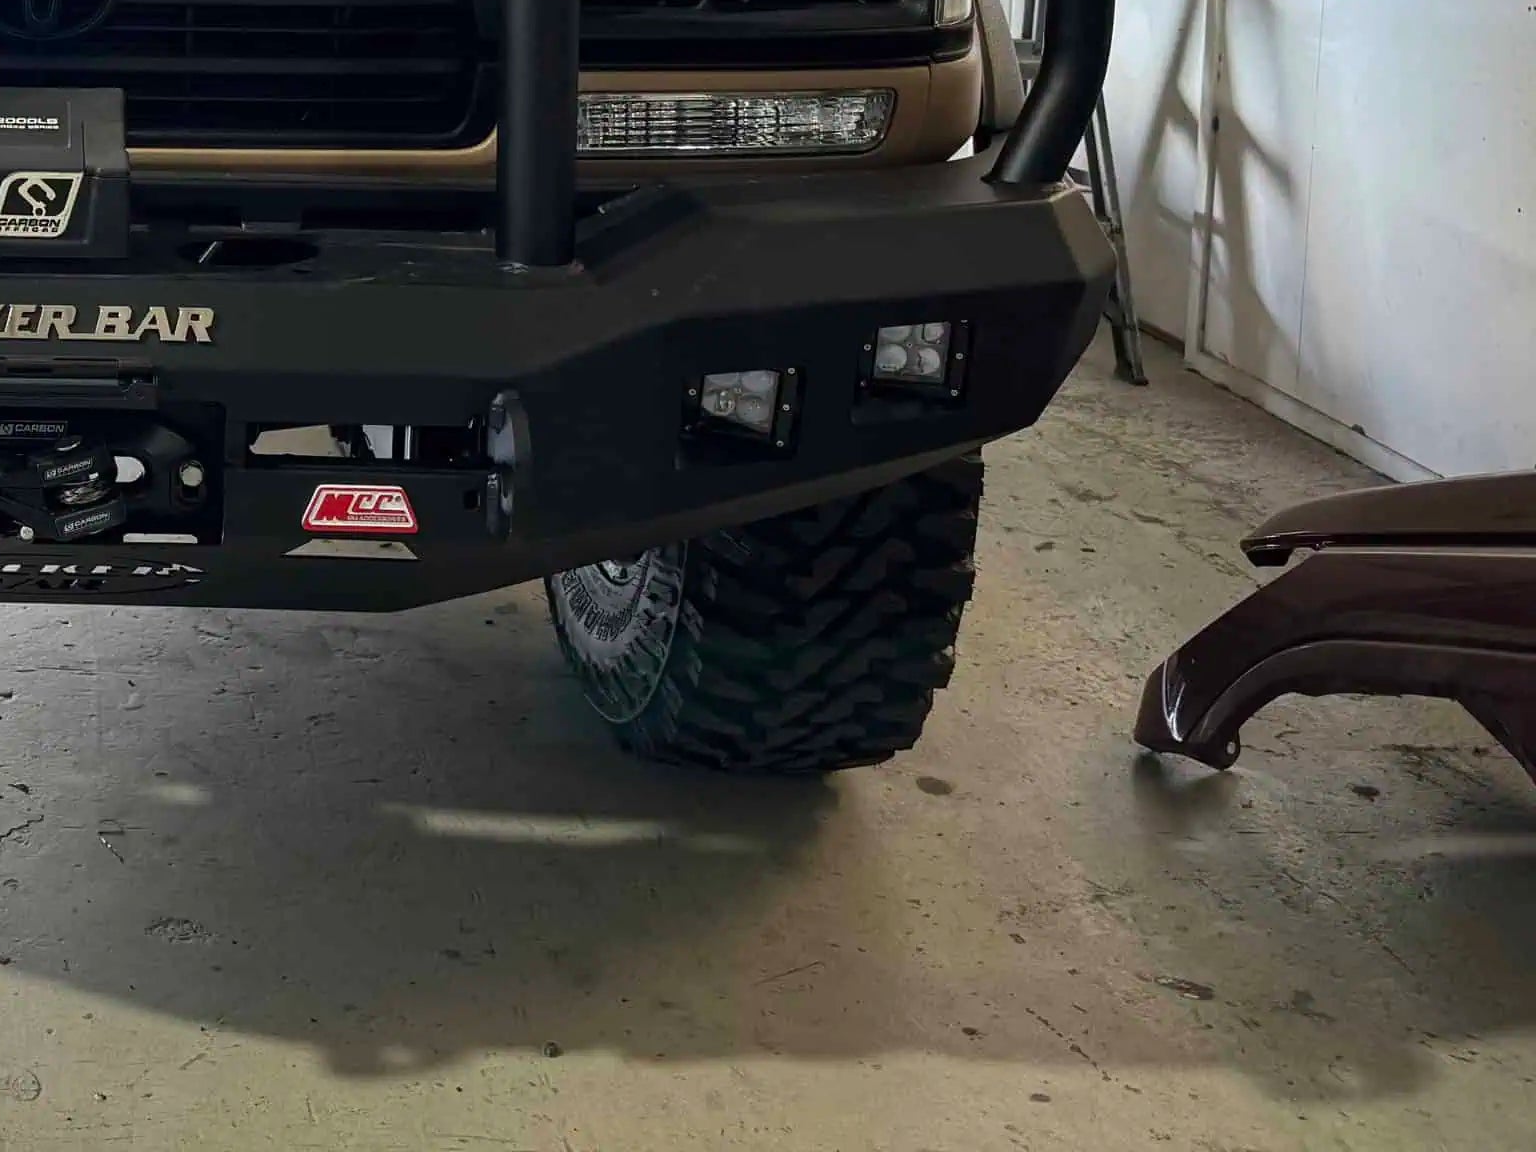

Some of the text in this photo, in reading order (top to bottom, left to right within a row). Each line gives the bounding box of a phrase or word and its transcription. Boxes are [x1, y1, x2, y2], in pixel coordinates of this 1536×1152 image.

[94, 305, 216, 342] BAR
[15, 423, 65, 433] CARBON
[316, 493, 406, 521] MCC
